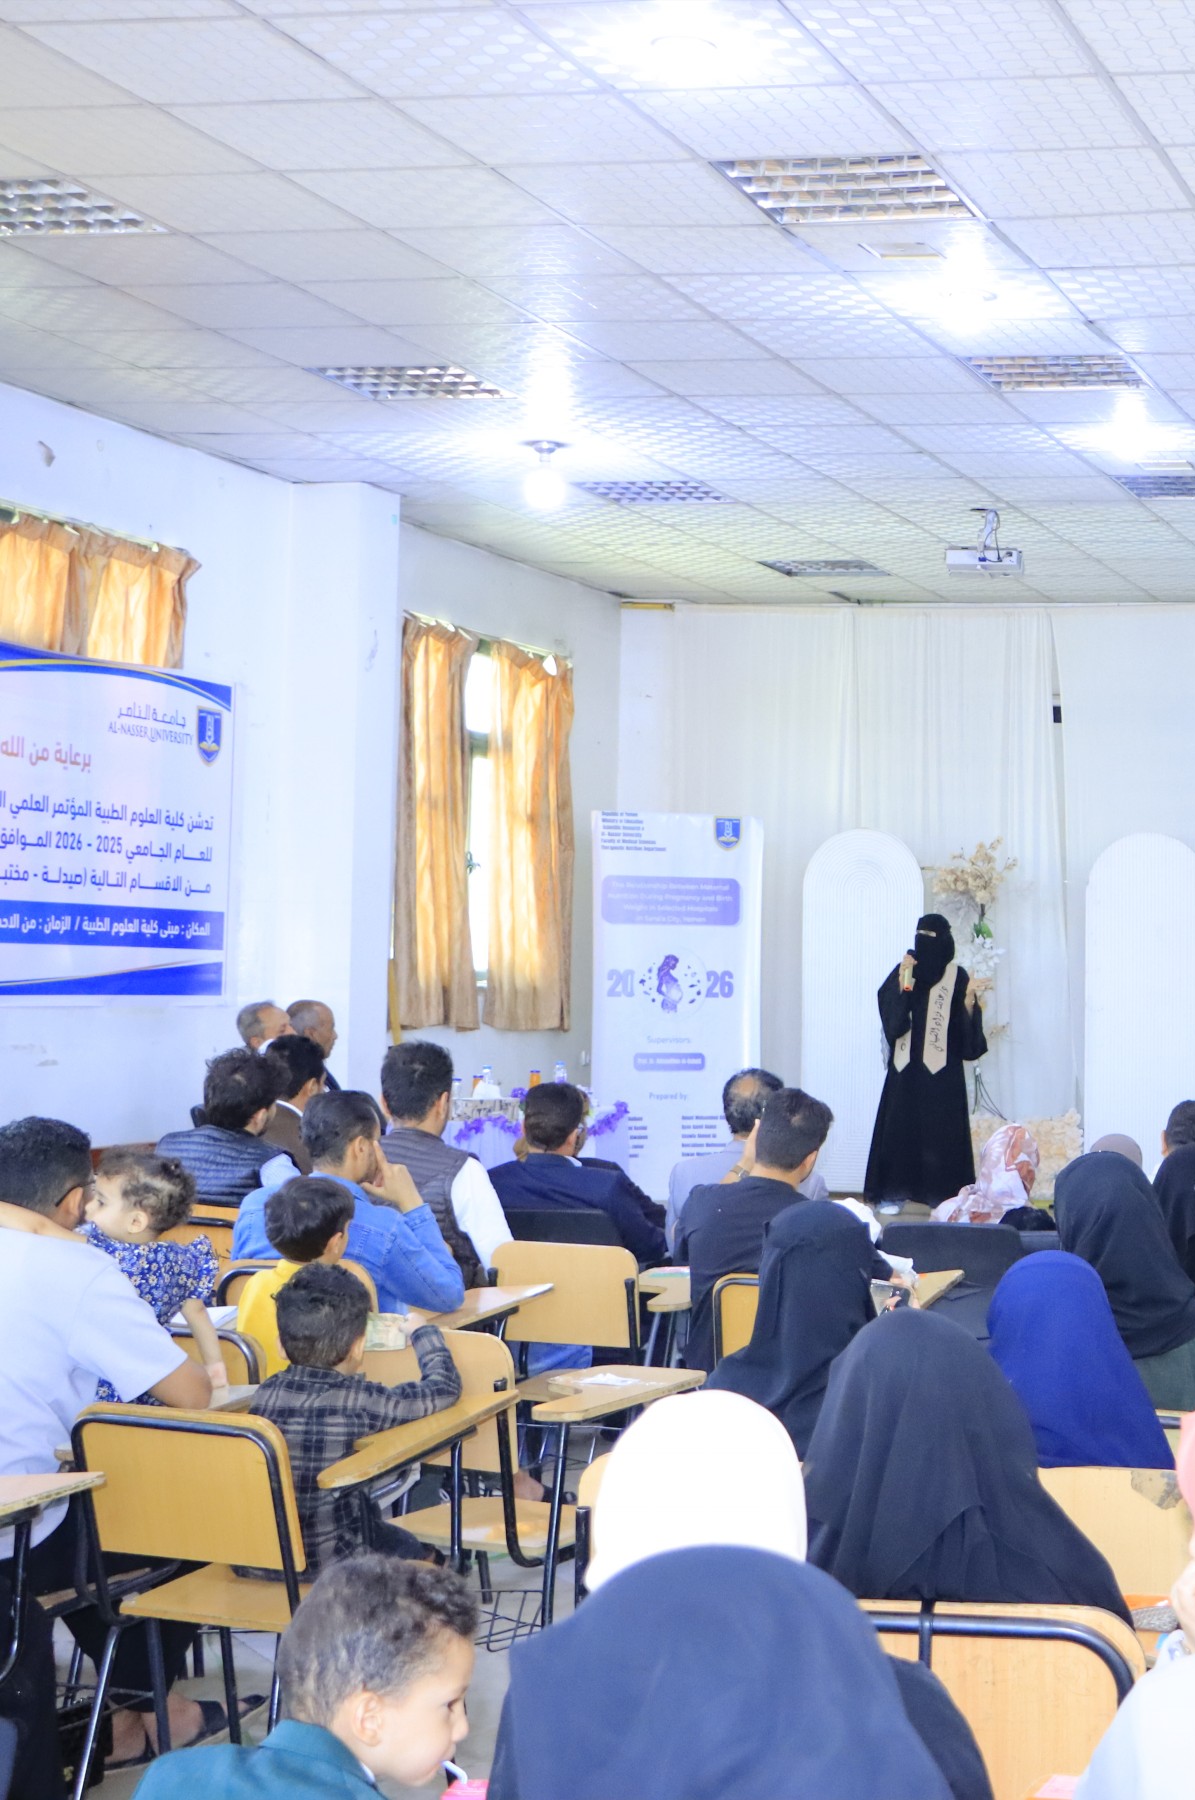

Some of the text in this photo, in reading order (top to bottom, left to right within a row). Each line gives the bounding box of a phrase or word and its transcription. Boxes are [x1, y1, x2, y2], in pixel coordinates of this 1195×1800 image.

[117, 701, 187, 728] جامعة الناصر
[107, 721, 194, 746] AL-NASSER UNIVERSITY
[0, 734, 92, 773] برعاية من الله
[9, 793, 49, 820] العلمي
[51, 797, 92, 823] المؤتمر
[95, 800, 127, 825] الطبية
[130, 807, 163, 828] العلوم
[164, 810, 185, 832] كلية
[55, 830, 83, 851] 2026
[96, 835, 123, 855] 2025
[126, 839, 171, 862] الجامعي
[90, 868, 127, 893] التالية
[21, 916, 37, 933] من
[44, 914, 71, 934] الزمان
[82, 916, 110, 936] الطبية
[111, 917, 140, 937] العلوم
[141, 919, 159, 938] كلية
[185, 922, 211, 939] المكان
[607, 969, 635, 998] 20
[705, 970, 734, 998] 26
